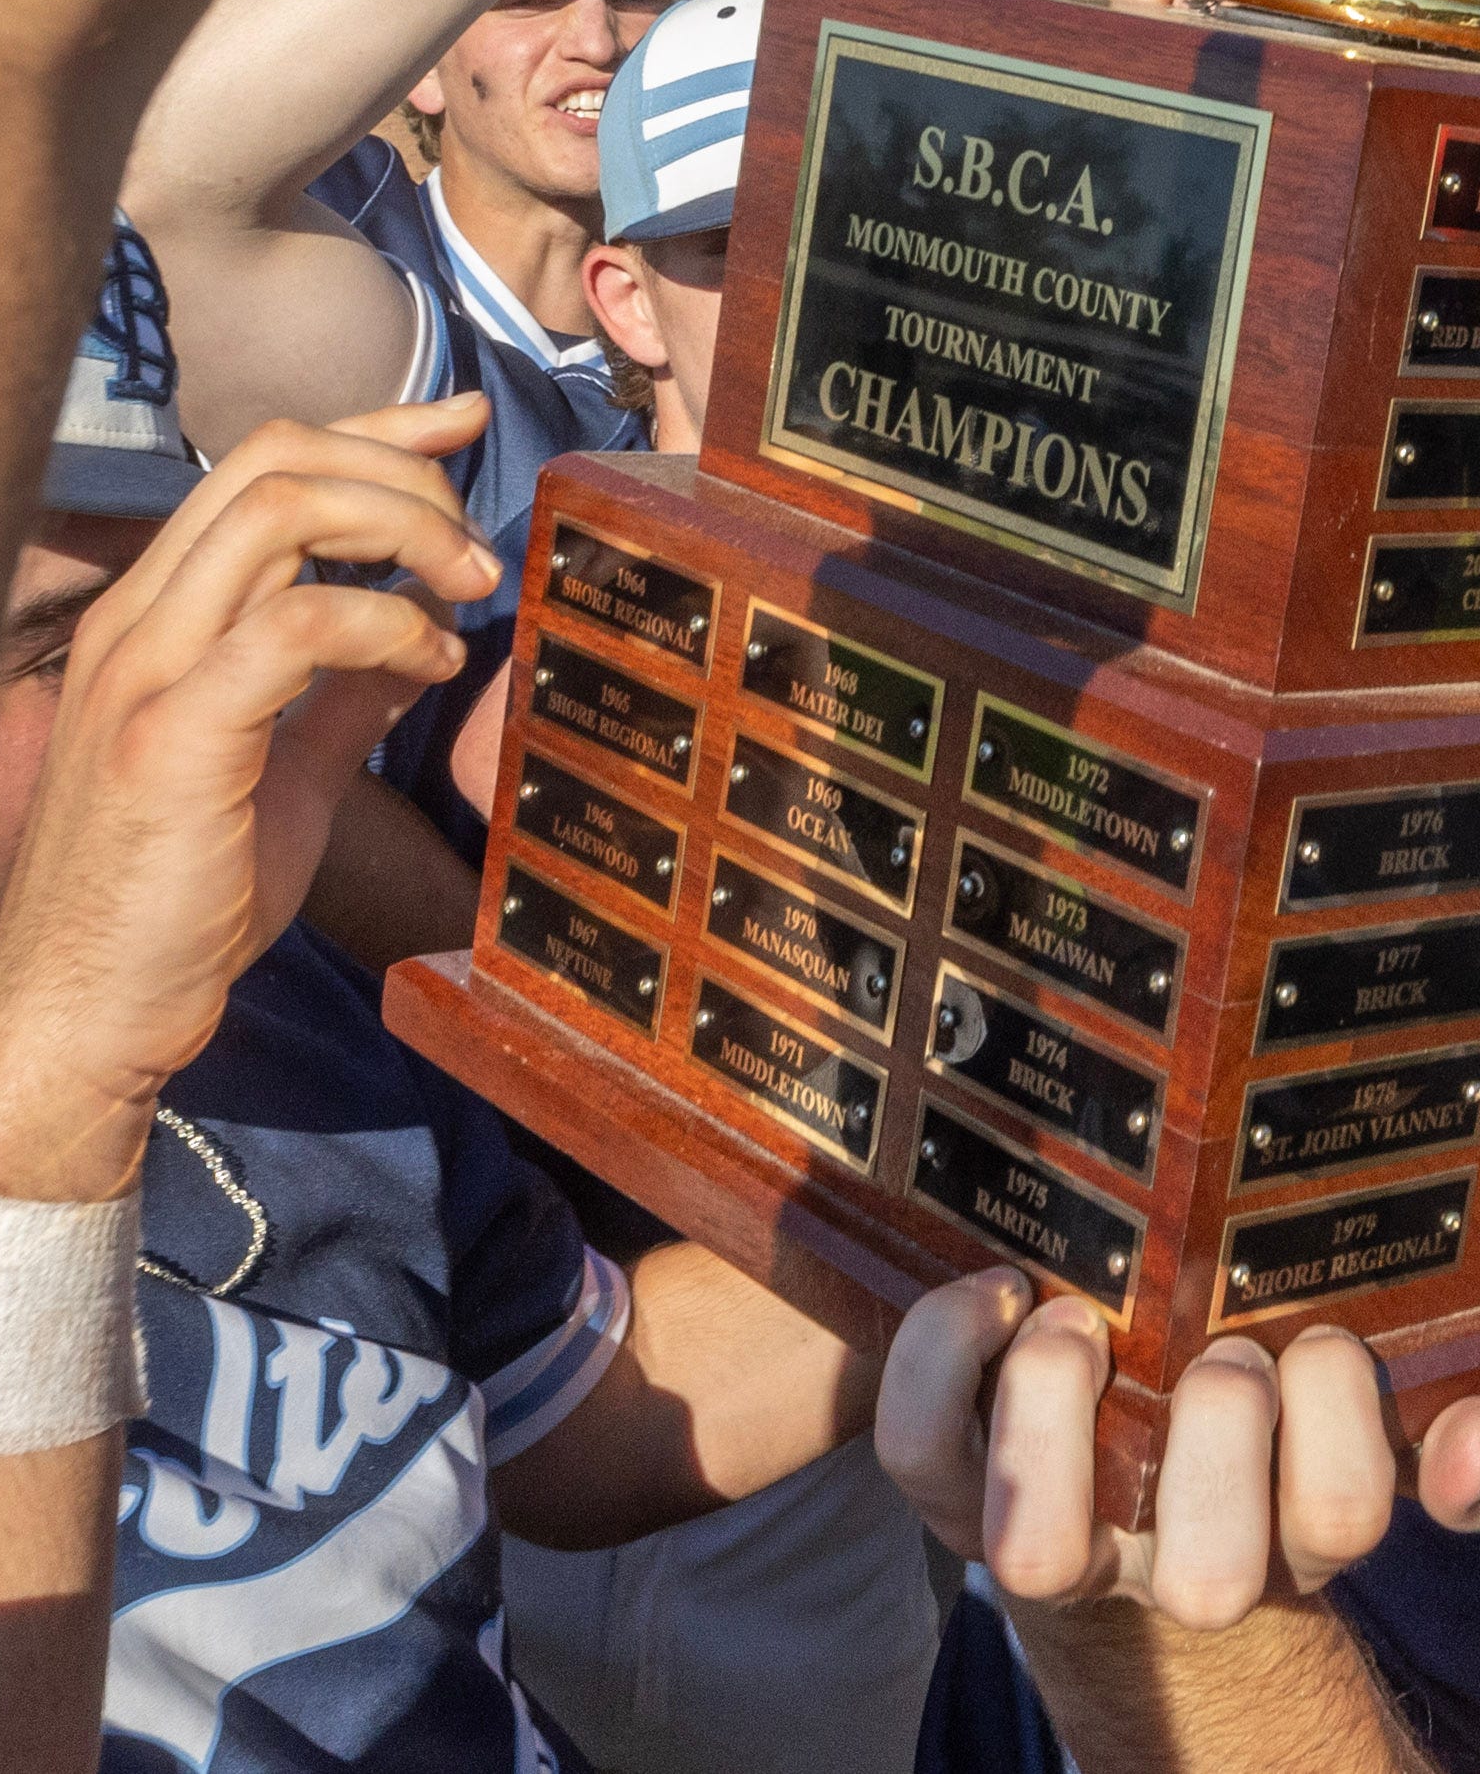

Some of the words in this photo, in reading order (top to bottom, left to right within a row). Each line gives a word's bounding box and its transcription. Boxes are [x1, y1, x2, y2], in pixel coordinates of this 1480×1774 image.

[913, 126, 1113, 236] S.B.C.A.
[846, 214, 1025, 296] MONMOUTH
[1033, 268, 1171, 337] COUNTY
[885, 306, 1100, 404] TOURNAMENT
[1430, 325, 1468, 349] RED
[820, 362, 1151, 528] CHAMPIONS
[615, 567, 646, 596] 1964
[561, 576, 613, 616] SHORE
[617, 596, 694, 654] REGIONAL
[824, 662, 858, 696] 1968
[547, 692, 599, 732] SHORE
[603, 710, 678, 771] REGIONAL
[790, 679, 848, 728] MATER
[850, 707, 885, 743] DEI
[806, 777, 842, 813] 1969
[1068, 753, 1109, 791] 1972
[787, 808, 852, 856] OCEAN
[1008, 768, 1160, 857] MIDDLETOWN
[1398, 809, 1444, 837] 1976
[552, 815, 639, 879] LAKEWOOD
[1378, 842, 1450, 877] BRICK
[568, 914, 599, 945] 1967
[783, 905, 818, 939] 1970
[1046, 894, 1087, 930] 1973
[545, 934, 614, 992] NEPTUNE
[742, 918, 852, 993] MANASQUAN
[1009, 913, 1116, 986] MATAWAN
[1376, 946, 1421, 973] 1977
[1355, 978, 1427, 1012] BRICK
[769, 1031, 805, 1067] 1971
[1026, 1030, 1067, 1068] 1974
[719, 1039, 847, 1130] MIDDLETOWN
[1008, 1057, 1076, 1112] BRICK
[1303, 1126, 1364, 1157] JOHN
[1369, 1103, 1468, 1142] VIANNEY
[1006, 1167, 1047, 1208] 1975
[974, 1186, 1068, 1262] RARITAN
[1241, 1263, 1325, 1300] SHORE
[1332, 1232, 1446, 1280] REGIONAL
